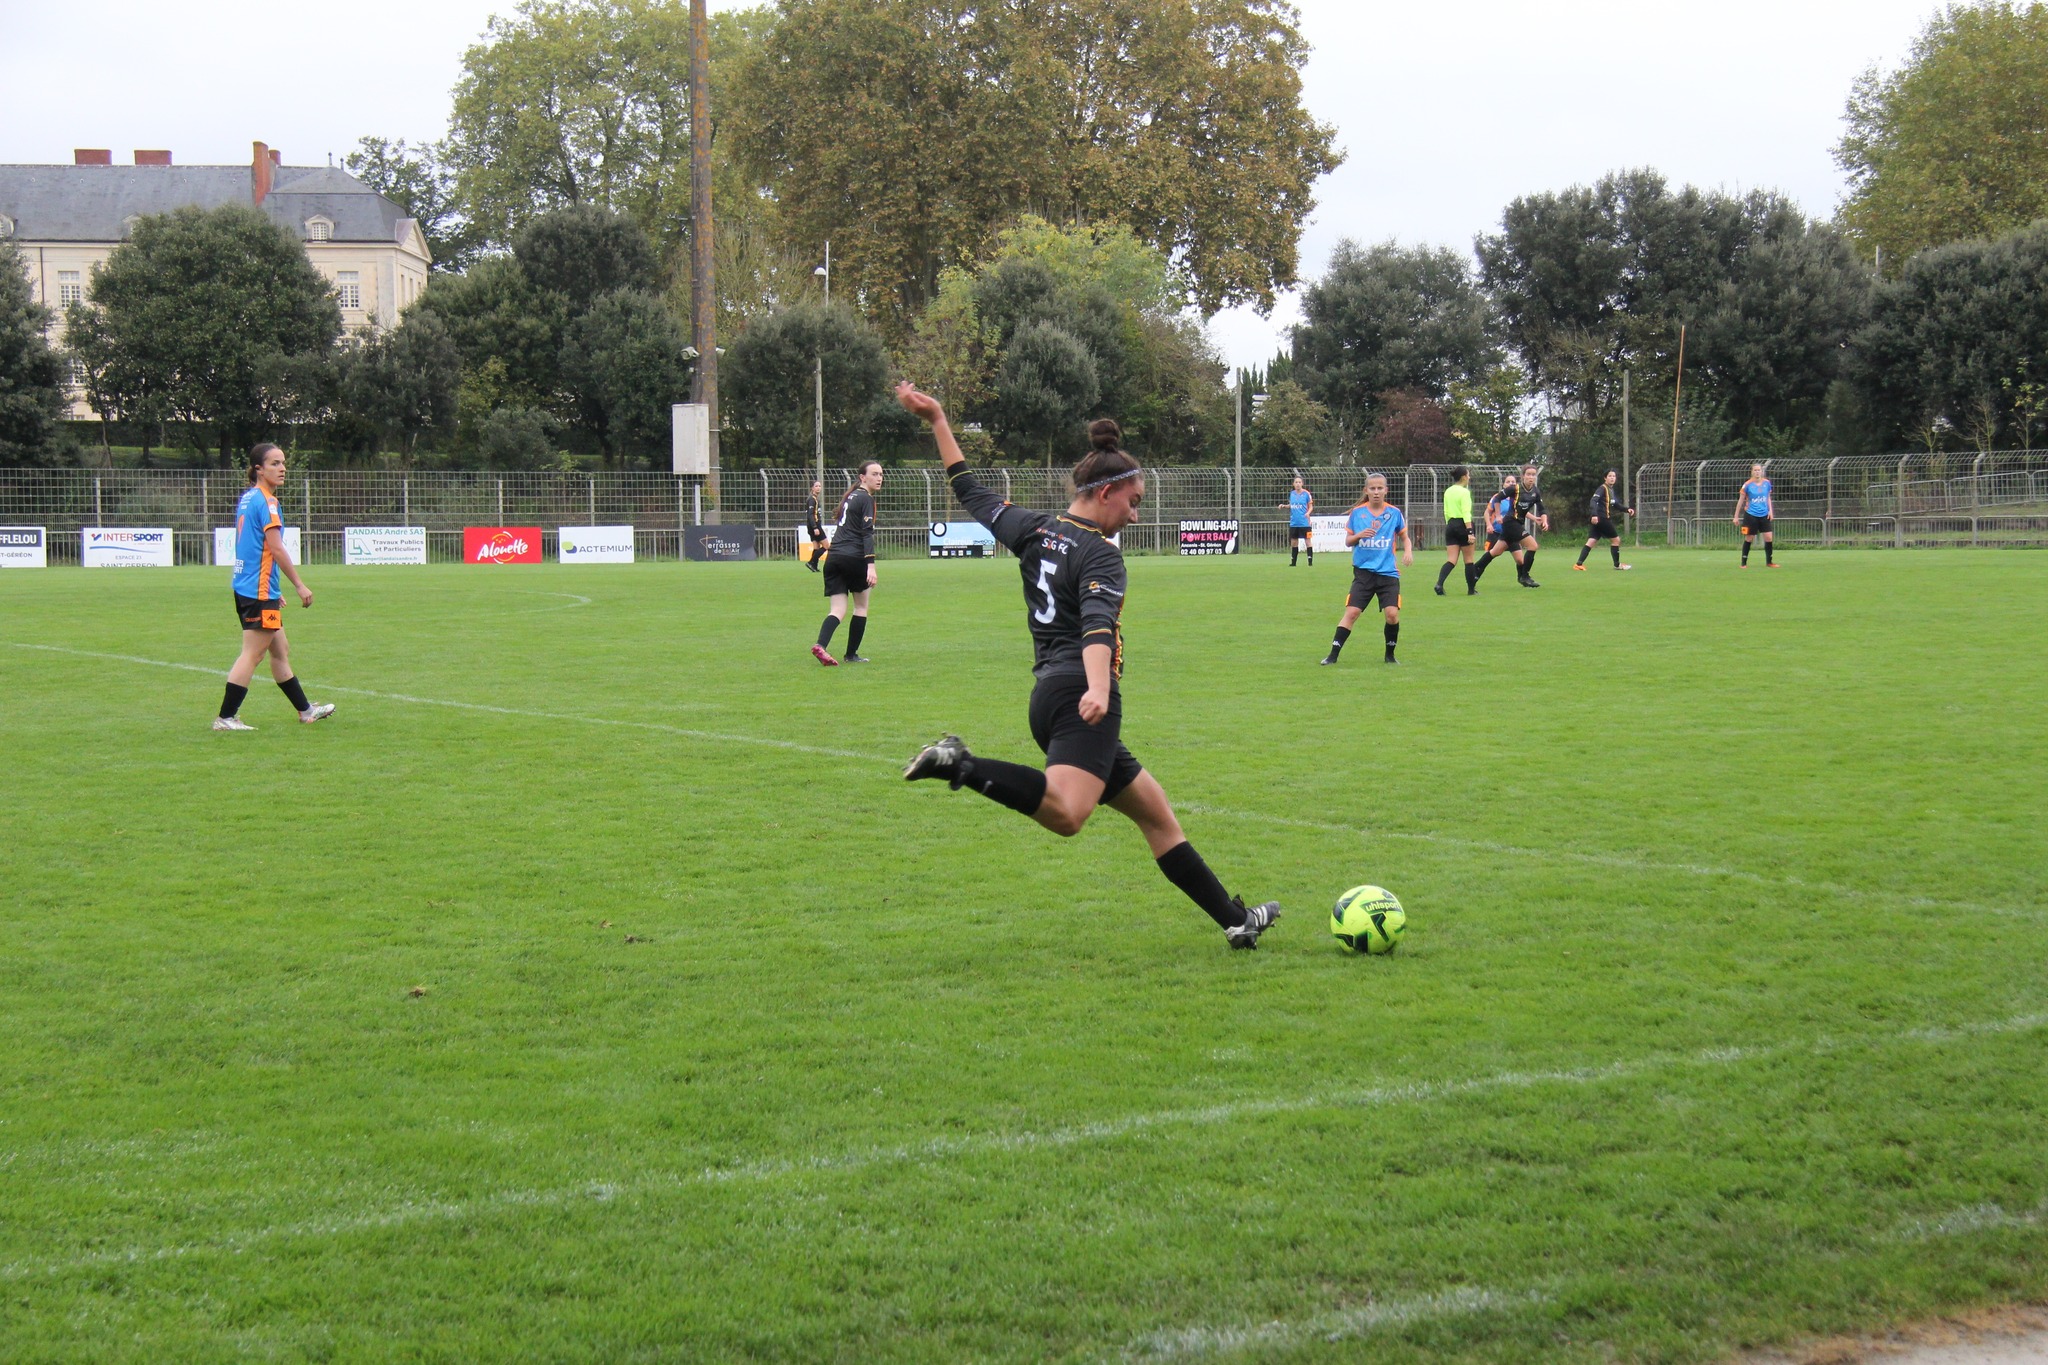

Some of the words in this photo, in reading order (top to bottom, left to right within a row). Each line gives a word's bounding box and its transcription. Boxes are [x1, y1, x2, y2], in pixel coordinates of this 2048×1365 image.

[1181, 520, 1238, 531] BOWLING-BAR
[1372, 520, 1381, 529] 10
[103, 533, 163, 541] INTERSPORT
[1181, 532, 1234, 542] POWERBALL
[477, 538, 528, 561] Alouette
[579, 545, 633, 553] ACTEMIUM
[1058, 543, 1068, 555] FC
[1034, 559, 1058, 624] 5
